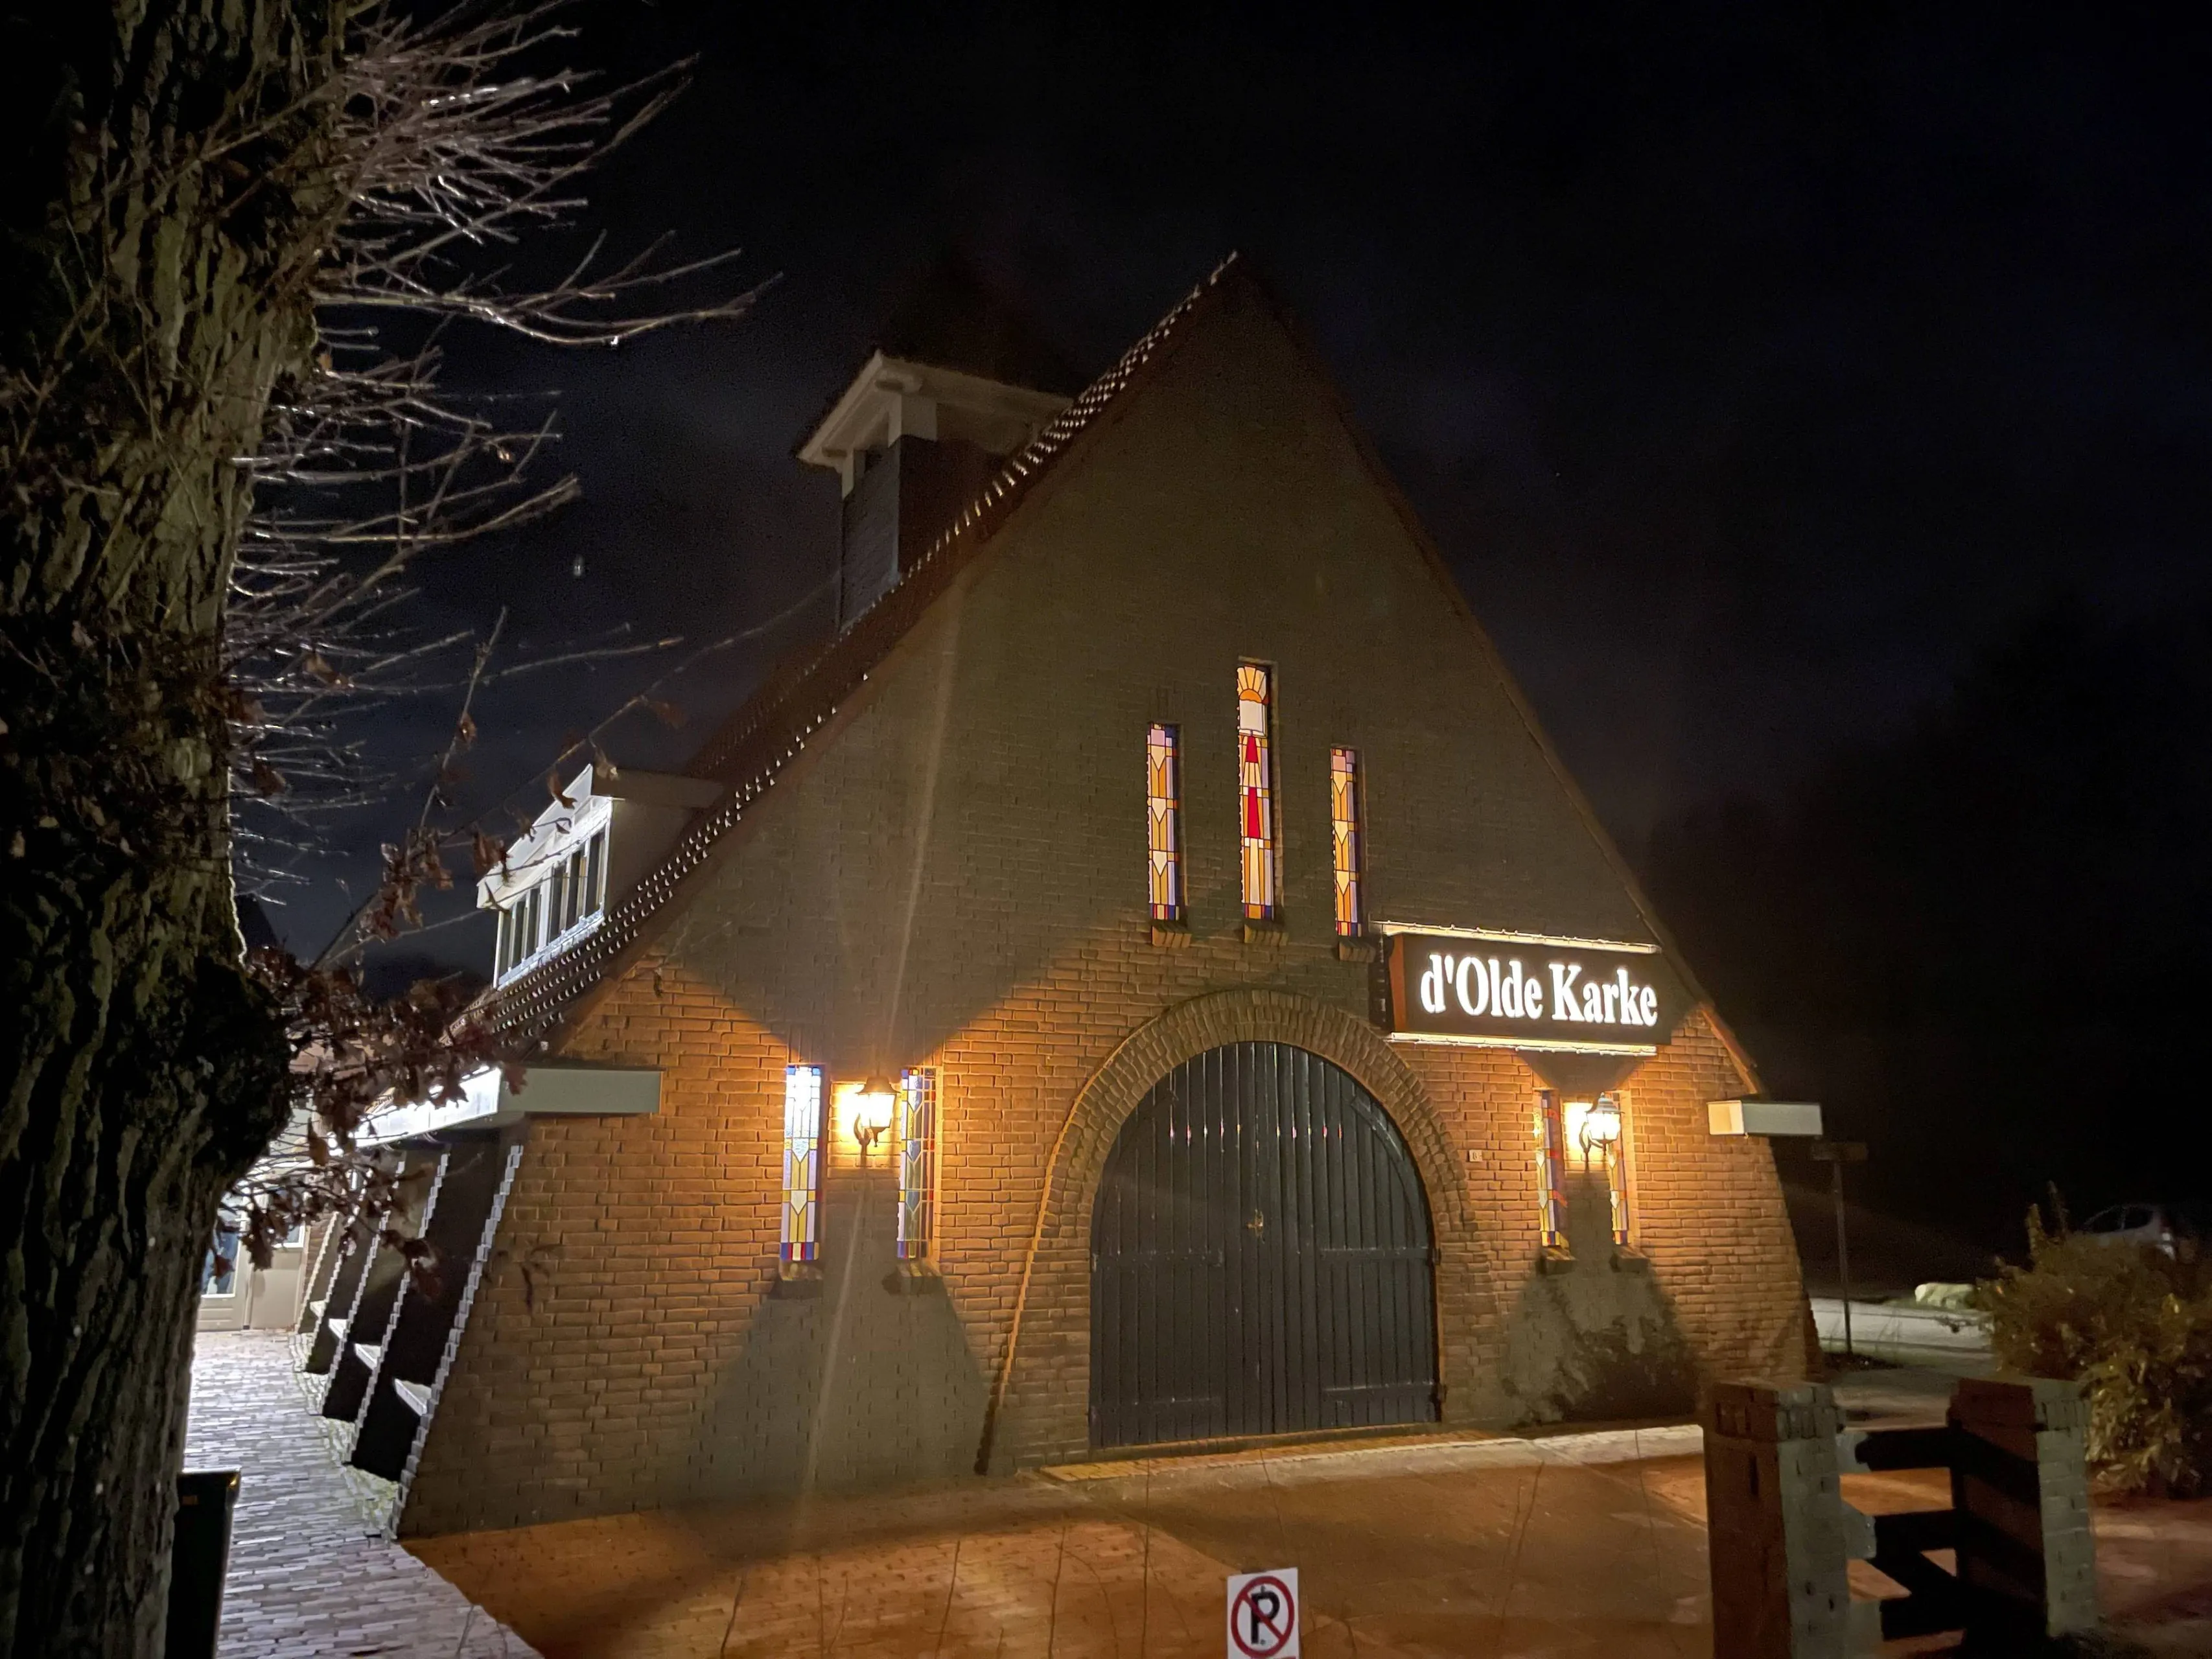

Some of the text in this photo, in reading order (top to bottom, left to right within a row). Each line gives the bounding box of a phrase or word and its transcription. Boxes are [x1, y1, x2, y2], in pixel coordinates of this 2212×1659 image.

[1421, 954, 1657, 1027] d'Olde Karke
[1251, 1591, 1281, 1644] P
